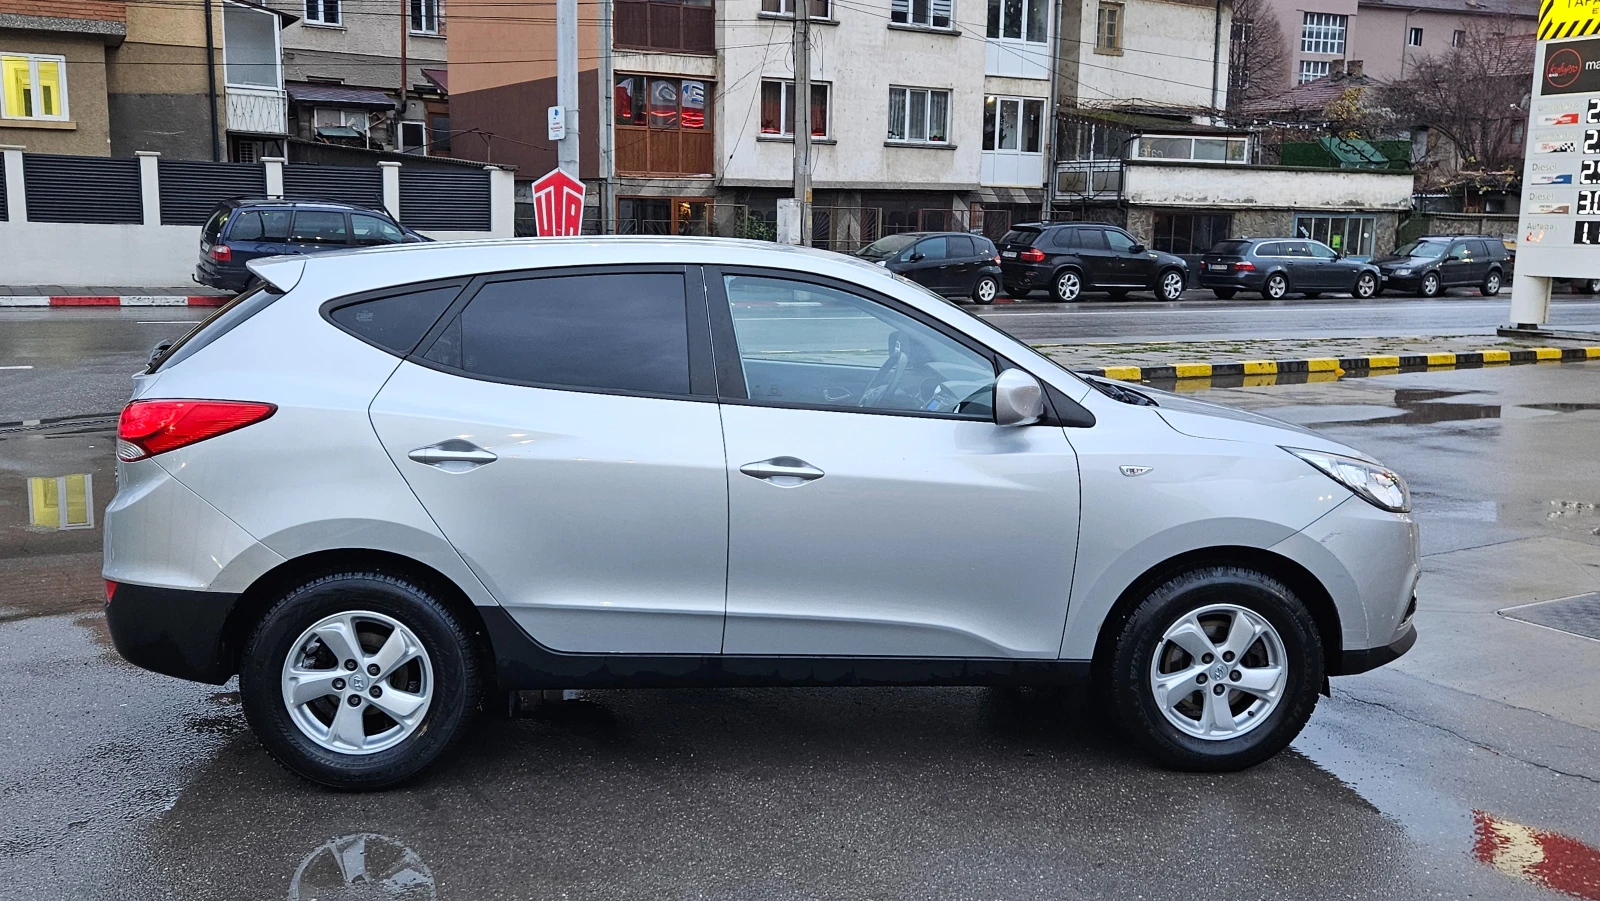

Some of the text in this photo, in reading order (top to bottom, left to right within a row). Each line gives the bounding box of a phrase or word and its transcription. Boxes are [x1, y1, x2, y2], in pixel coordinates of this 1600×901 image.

[1532, 163, 1557, 171] Diesel
[1529, 192, 1554, 201] Diesel
[1526, 222, 1558, 230] Autogas
